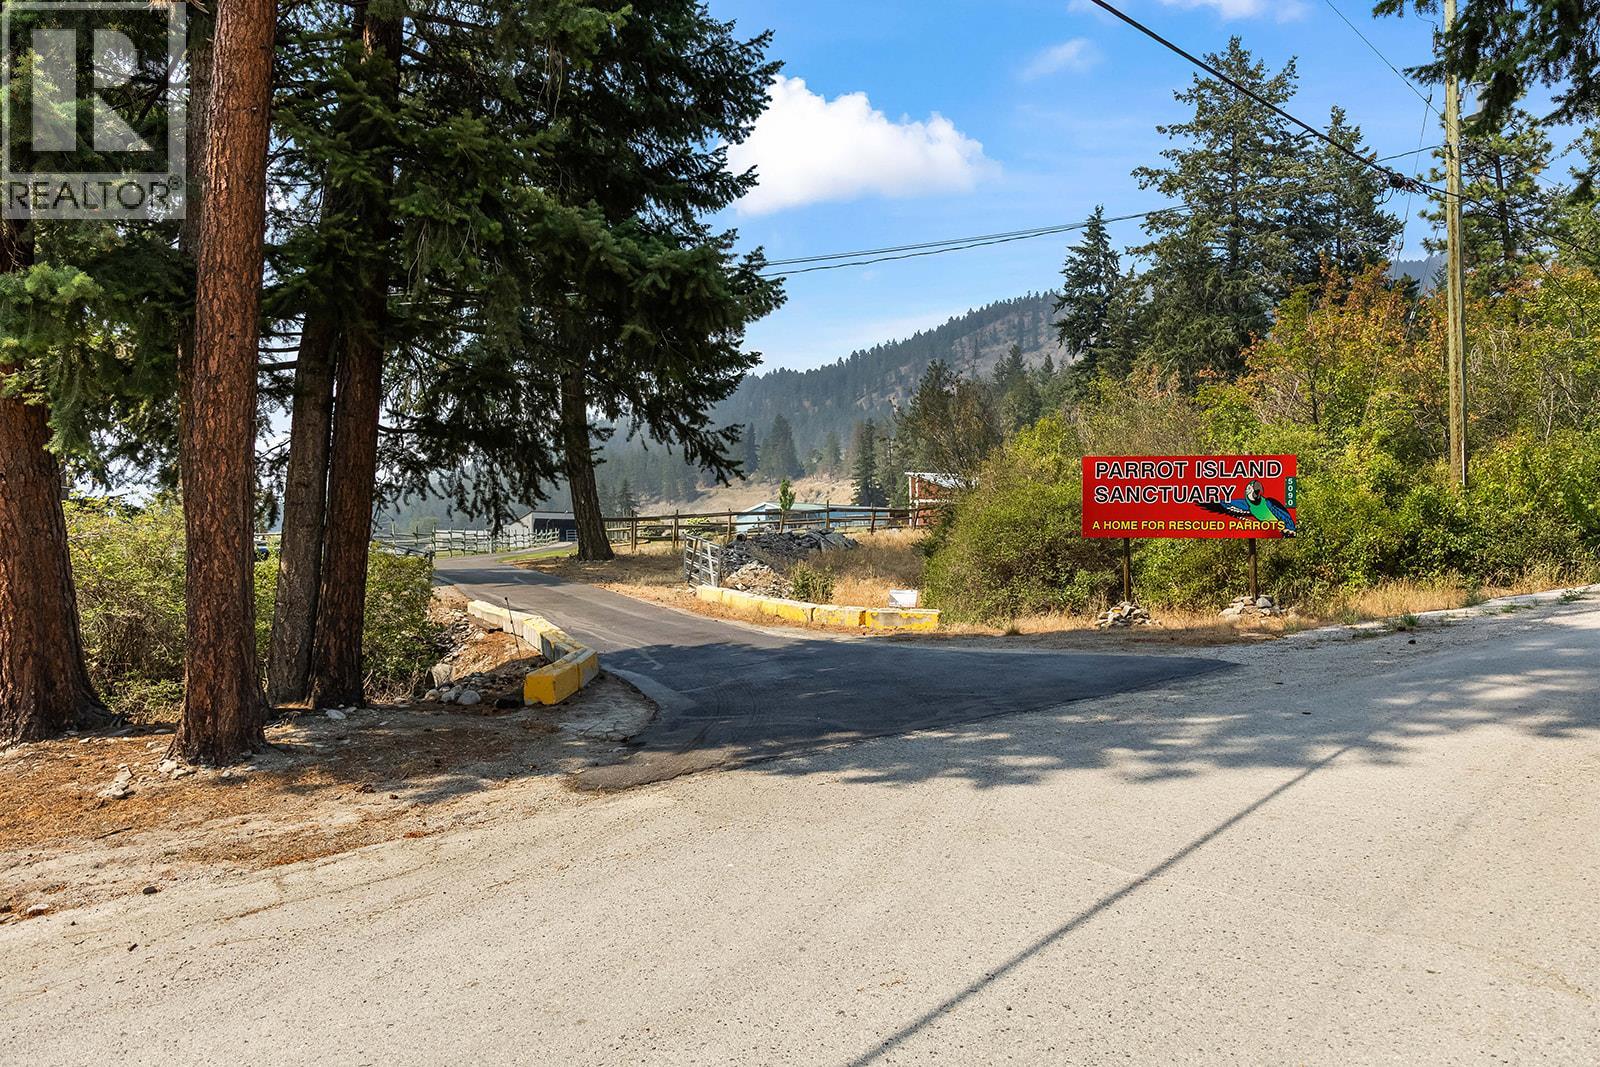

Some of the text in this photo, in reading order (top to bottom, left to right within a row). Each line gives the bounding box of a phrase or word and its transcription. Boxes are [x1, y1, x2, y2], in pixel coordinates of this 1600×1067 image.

[1094, 460, 1283, 479] PARROT ISLAND
[1094, 485, 1236, 504] SANCTUARY
[1092, 520, 1286, 531] A HOME FOR RESCUED PARROTS
